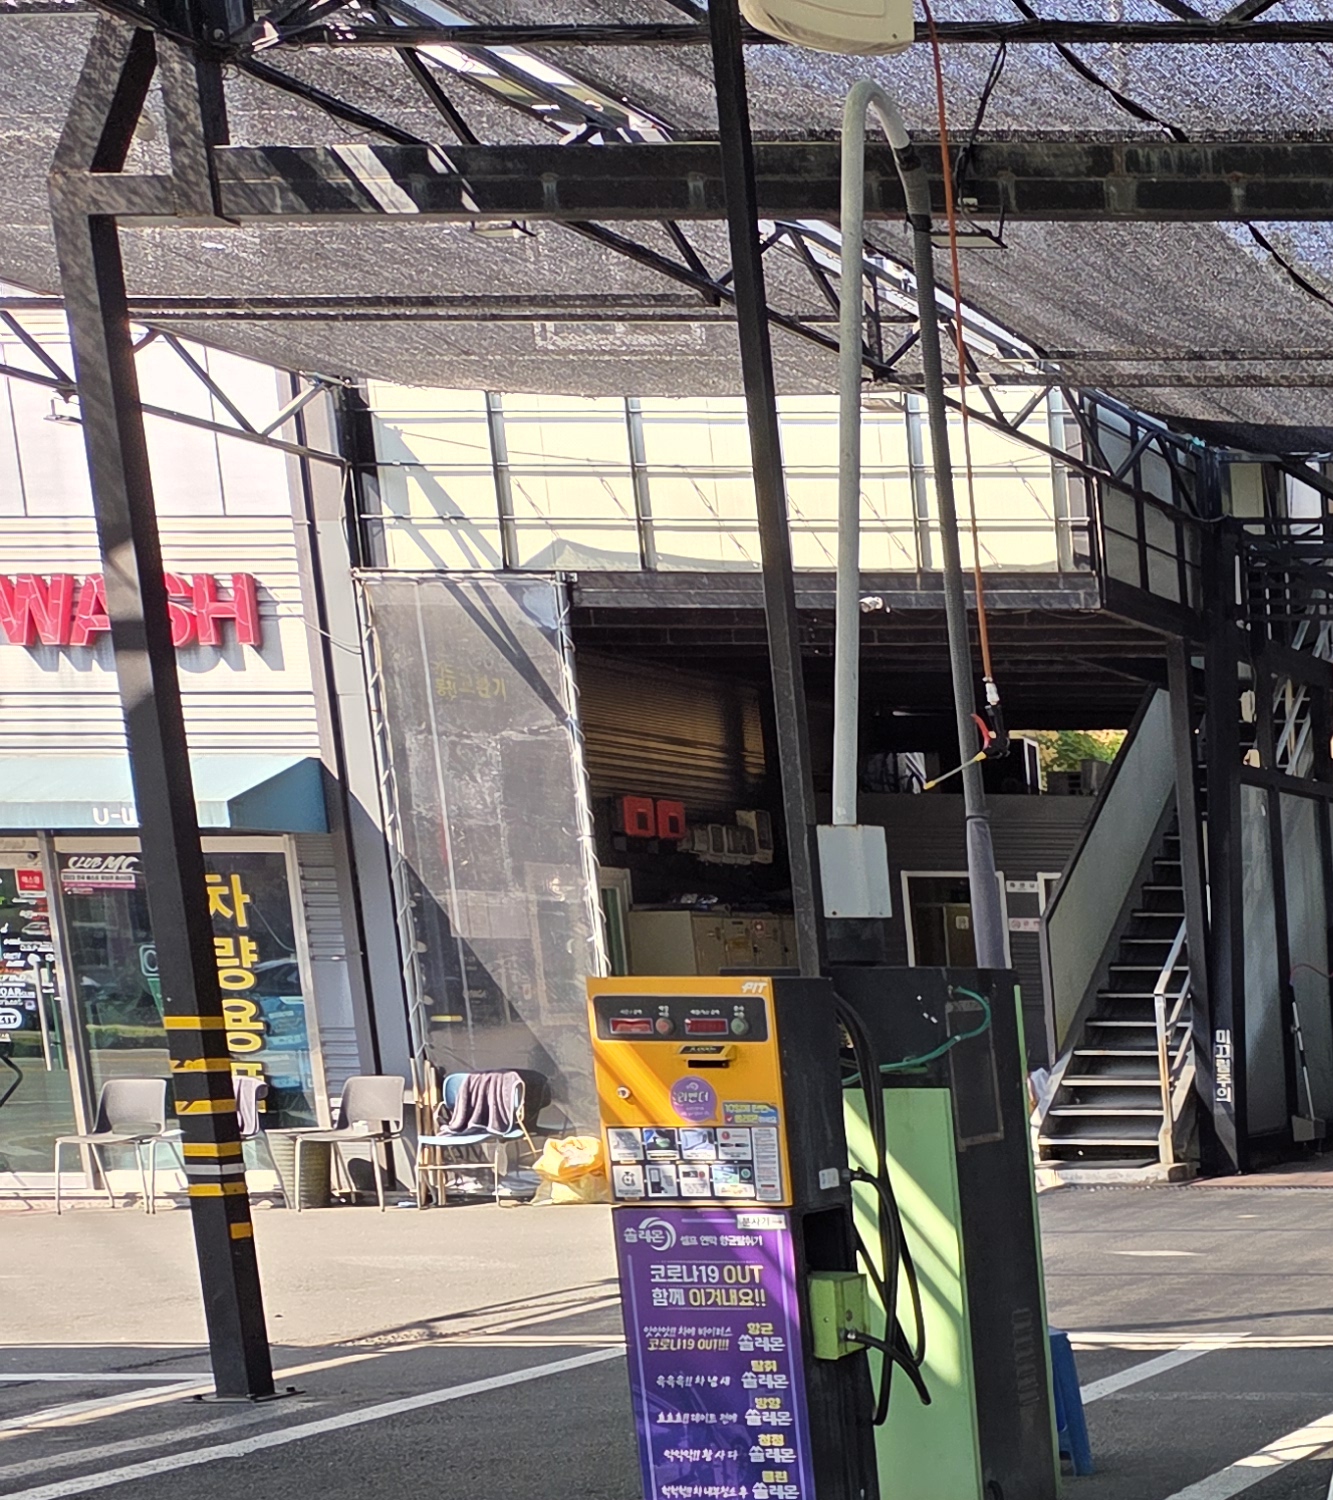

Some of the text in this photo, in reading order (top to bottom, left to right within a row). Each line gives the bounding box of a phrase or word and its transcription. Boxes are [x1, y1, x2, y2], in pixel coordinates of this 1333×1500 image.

[650, 1265, 763, 1284] 코로나19 OUT
[652, 1288, 686, 1307] 함께
[648, 1338, 695, 1351] 코로나19
